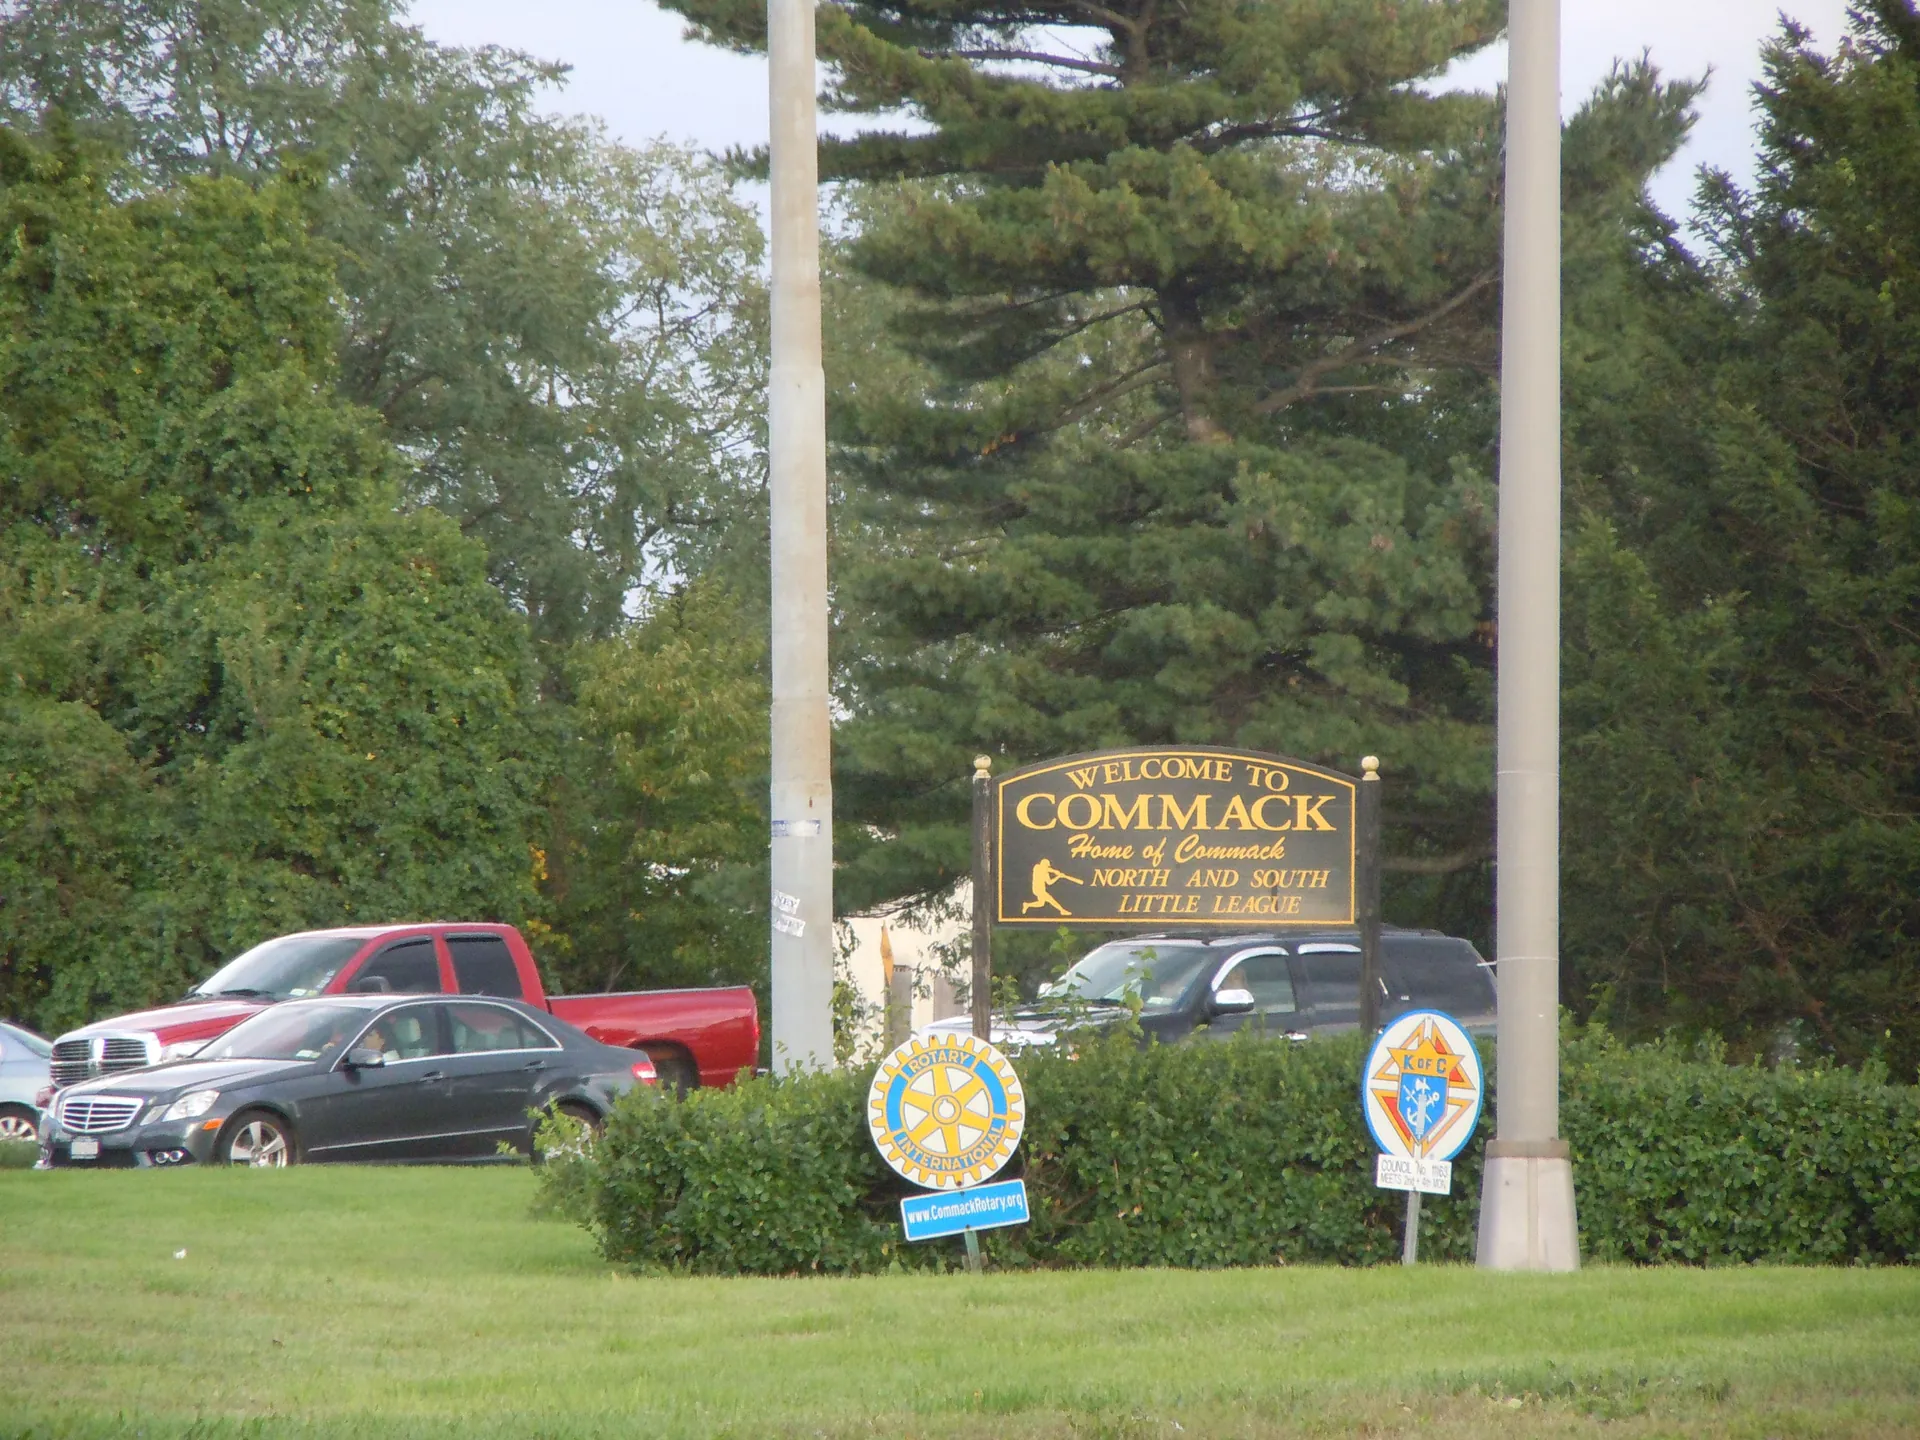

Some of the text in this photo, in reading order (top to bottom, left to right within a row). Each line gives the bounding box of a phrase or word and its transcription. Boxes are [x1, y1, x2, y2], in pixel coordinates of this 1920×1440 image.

[1065, 757, 1290, 792] WELCOME TO
[1016, 792, 1337, 832] COMMACK
[1067, 833, 1286, 867] Home of Commack
[1090, 868, 1331, 889] NORTH AND SOUTH
[1117, 894, 1302, 914] LITTLE LEAGUE
[909, 1051, 970, 1073] ROTARY
[1403, 1054, 1415, 1070] K
[1436, 1058, 1447, 1074] C
[897, 1124, 1004, 1171] INTERNATIONAL
[1381, 1159, 1412, 1174] COUNCIL
[1380, 1172, 1402, 1185] MEETS
[907, 1192, 1023, 1224] www.CommackRotary.org
